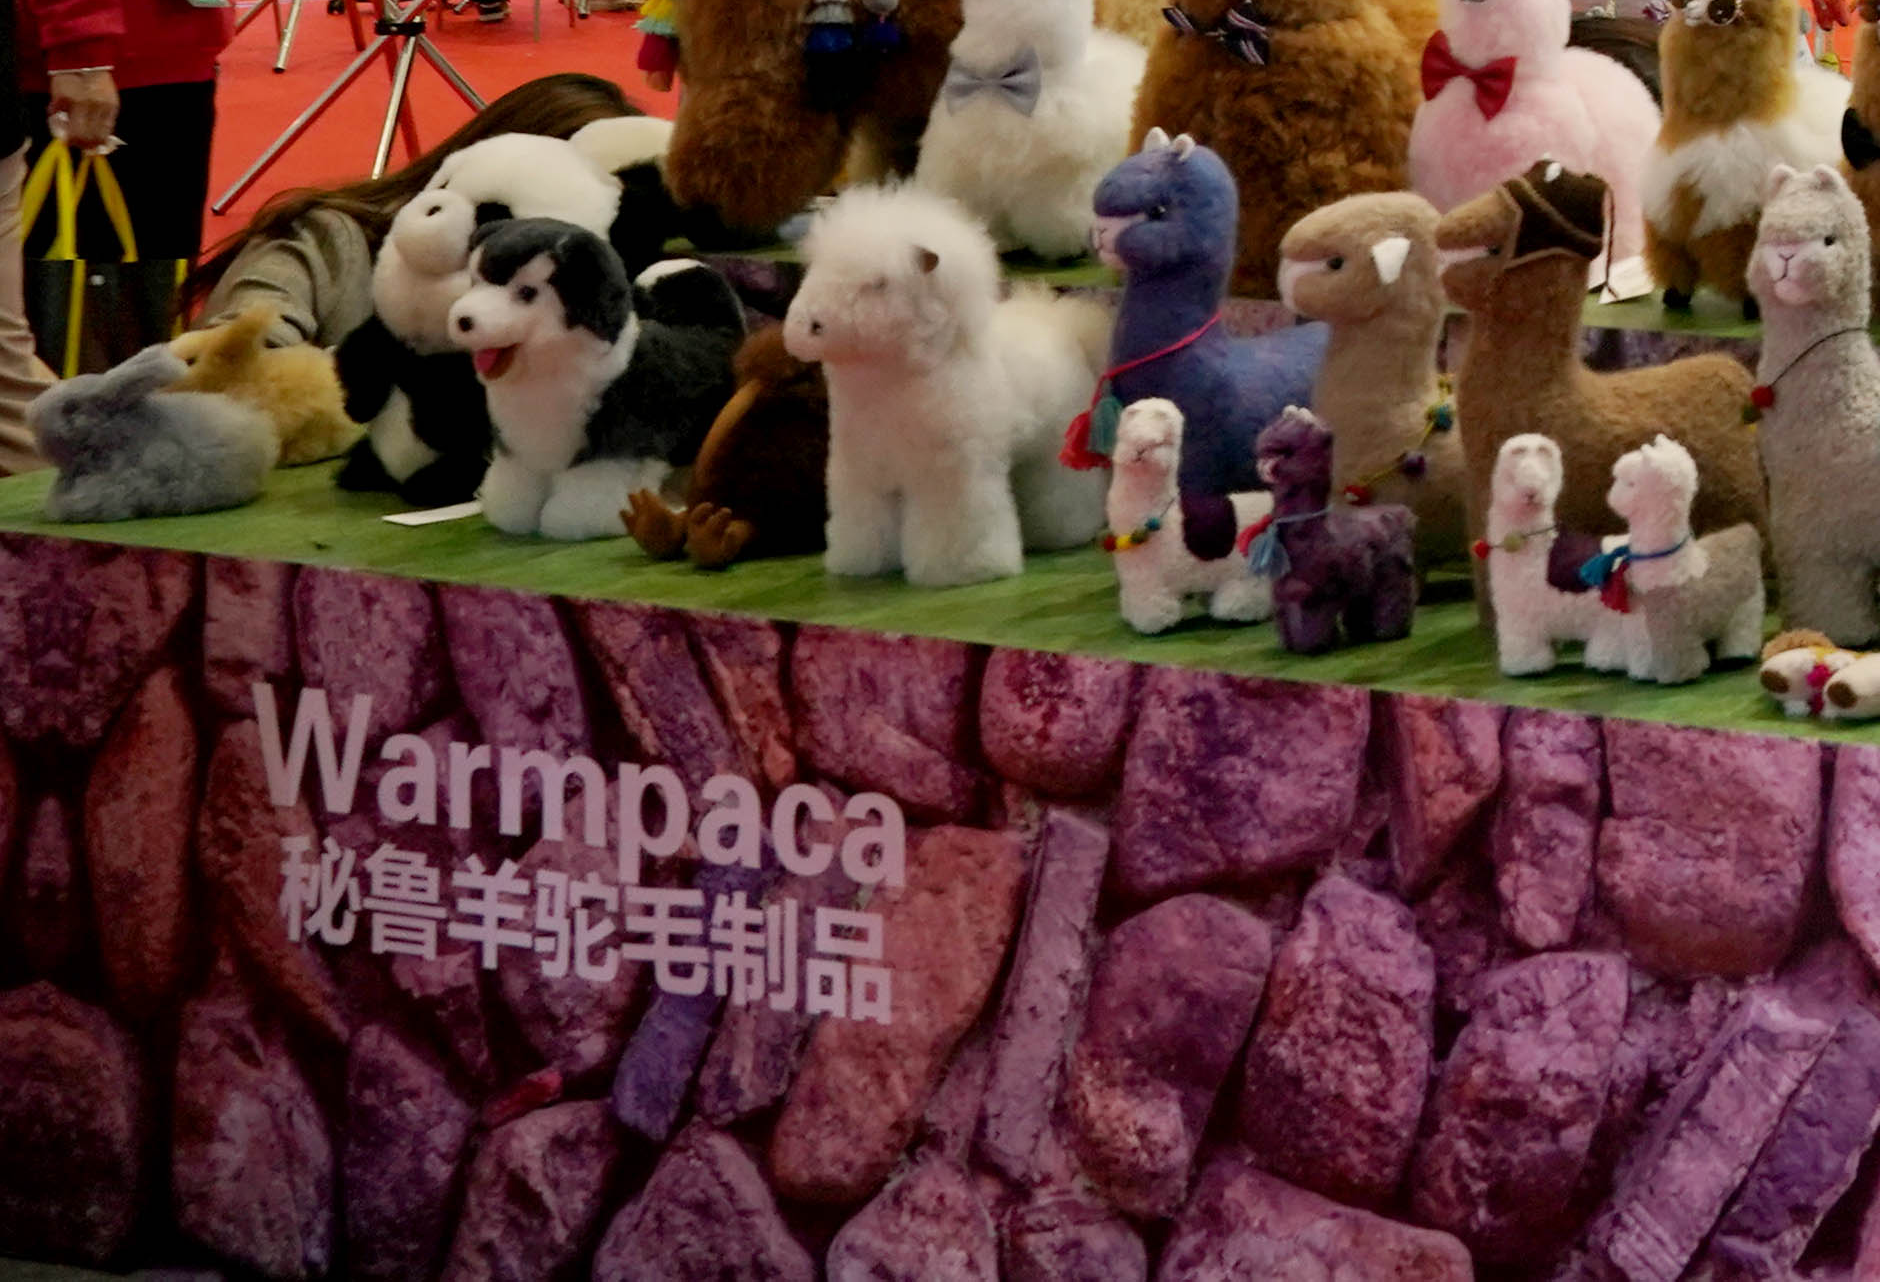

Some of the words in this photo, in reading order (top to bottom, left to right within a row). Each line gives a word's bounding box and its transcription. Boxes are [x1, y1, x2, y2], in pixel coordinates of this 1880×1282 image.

[252, 681, 906, 889] Warmpaca
[280, 835, 893, 1025] 秘鲁羊驼毛制品
